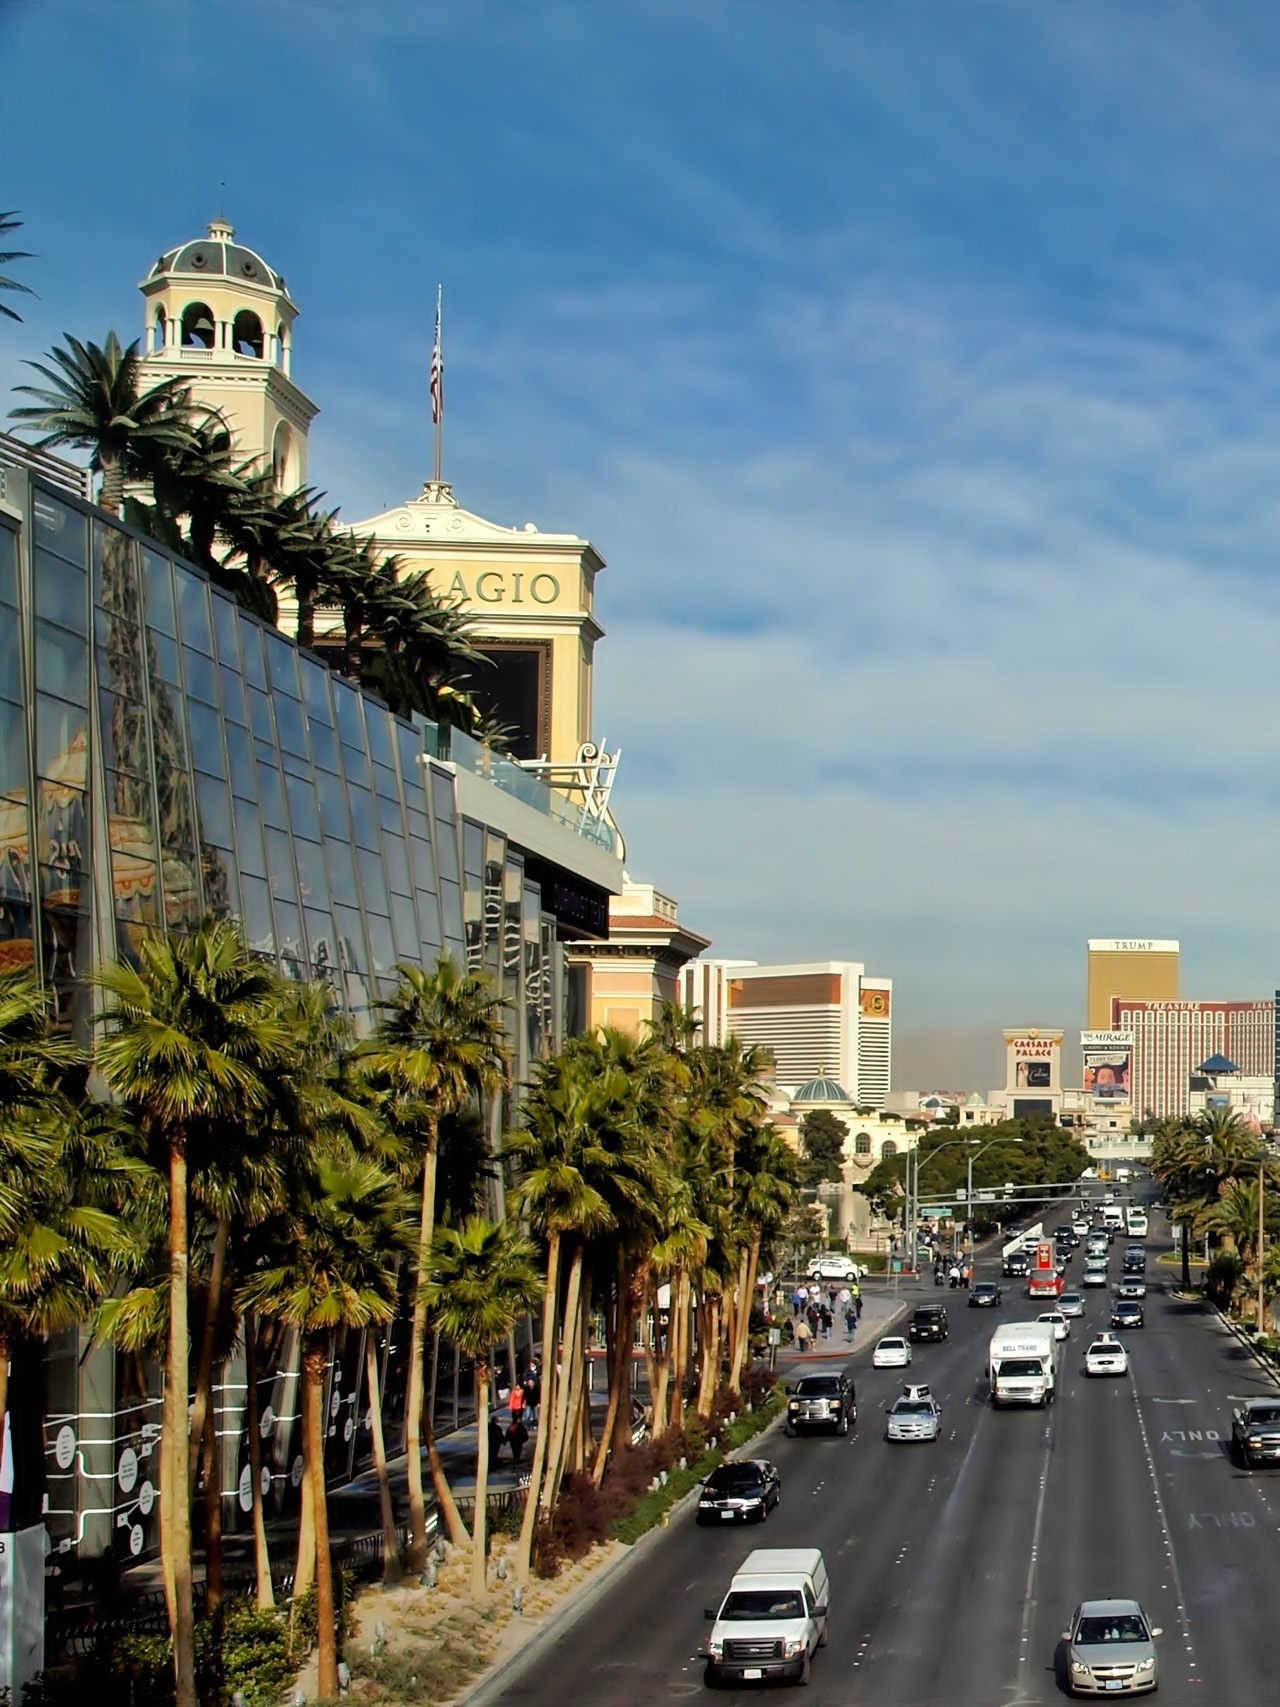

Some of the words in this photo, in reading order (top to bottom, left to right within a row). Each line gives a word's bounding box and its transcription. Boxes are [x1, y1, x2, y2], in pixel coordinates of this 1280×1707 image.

[448, 570, 561, 604] AGIO
[1114, 941, 1154, 950] TRUMP
[1145, 1002, 1200, 1010] TREASURE
[1251, 1001, 1276, 1010] ISLA
[1087, 1033, 1131, 1042] MIRAGE
[1014, 1040, 1053, 1048] CAESARS
[1161, 1430, 1220, 1441] ONLY
